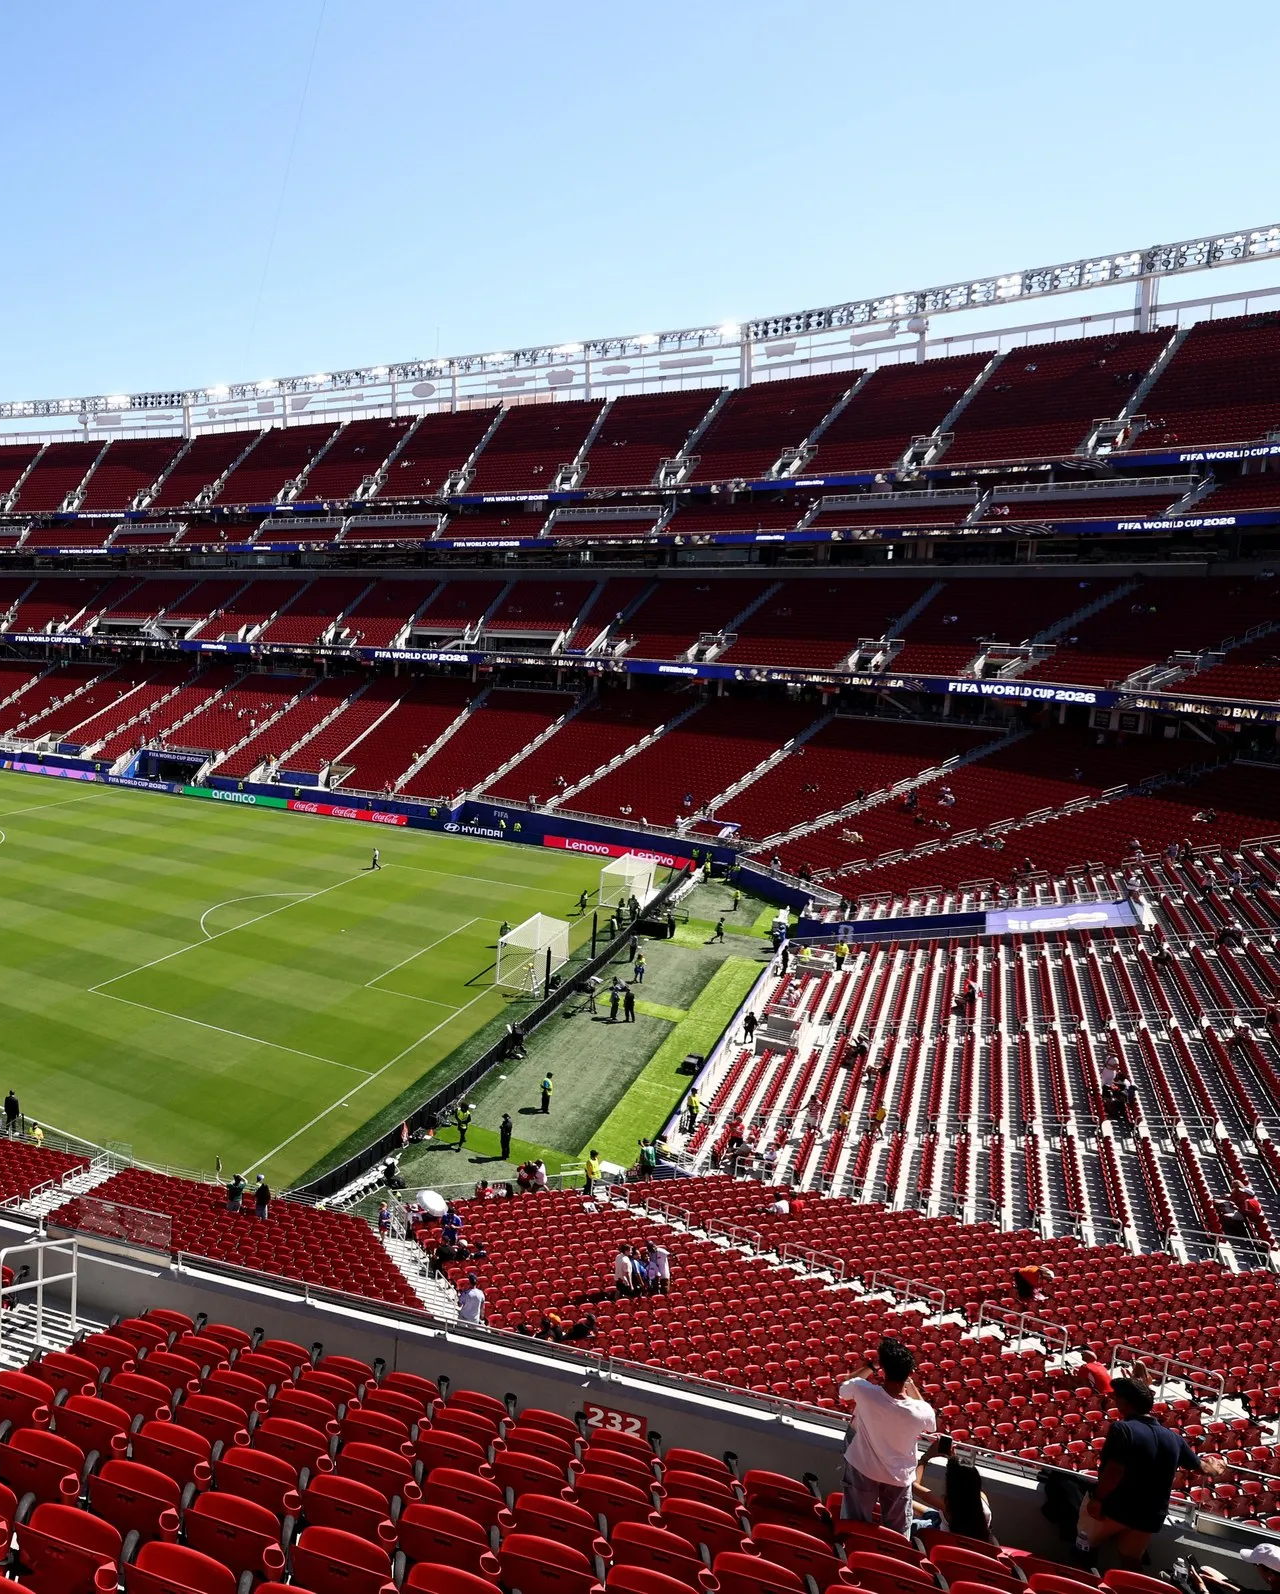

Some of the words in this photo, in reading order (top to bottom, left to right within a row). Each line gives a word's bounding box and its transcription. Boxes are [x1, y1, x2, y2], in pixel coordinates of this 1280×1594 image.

[1180, 453, 1204, 461] FIFA
[1206, 450, 1249, 459] WORLD
[1251, 448, 1269, 456] CUP
[1118, 522, 1142, 530] FIFA
[1143, 520, 1184, 529] WORLD
[1185, 519, 1202, 527] CUP
[1203, 517, 1235, 526] 2026
[439, 654, 468, 662] 2026
[512, 657, 557, 666] RANCISCO
[558, 659, 574, 667] BAY
[772, 672, 791, 680] SAN
[852, 677, 873, 686] BAY
[949, 683, 978, 692] FIFA
[981, 684, 1032, 696] WORLD
[1033, 688, 1055, 699] CUP
[1055, 690, 1096, 703] 2026
[1136, 698, 1159, 709] SAN
[1232, 707, 1258, 719] BAY
[120, 778, 137, 786] WORLD
[212, 790, 256, 804] aramco
[294, 801, 318, 813] Coca-Cola
[332, 806, 358, 819] Coca-Cola
[372, 812, 399, 824] Coca-Cola
[494, 810, 508, 819] FIFA
[461, 826, 503, 838] HYUNDAI
[565, 839, 609, 855] Lenovo
[631, 849, 674, 865] Lenovo
[588, 1407, 641, 1438] 232
